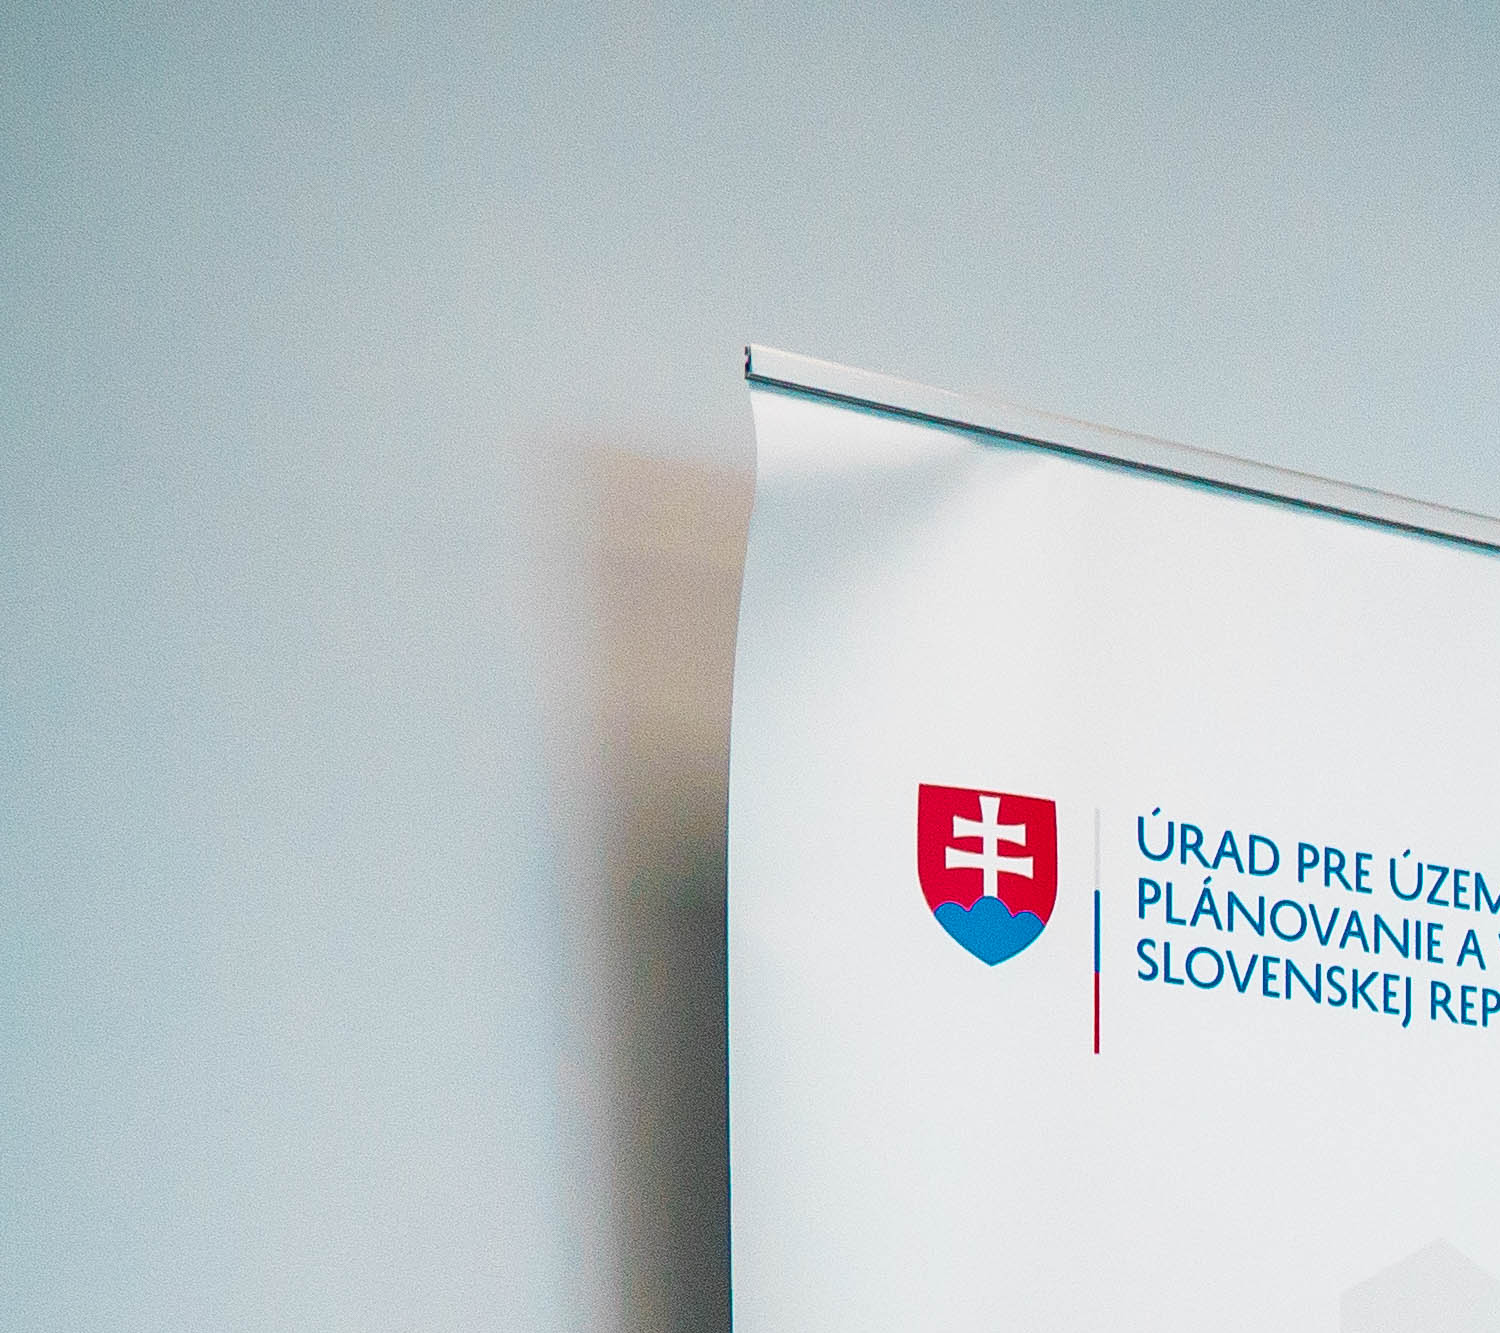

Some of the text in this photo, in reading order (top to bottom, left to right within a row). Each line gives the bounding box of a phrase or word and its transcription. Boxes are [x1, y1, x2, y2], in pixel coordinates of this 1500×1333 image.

[1137, 807, 1281, 877] ÚRAD
[1297, 841, 1374, 895] PRE
[1138, 875, 1445, 965] PLÁNOVANIE
[1456, 928, 1487, 971] A
[1136, 937, 1412, 1029] SLOVENSKEJ
